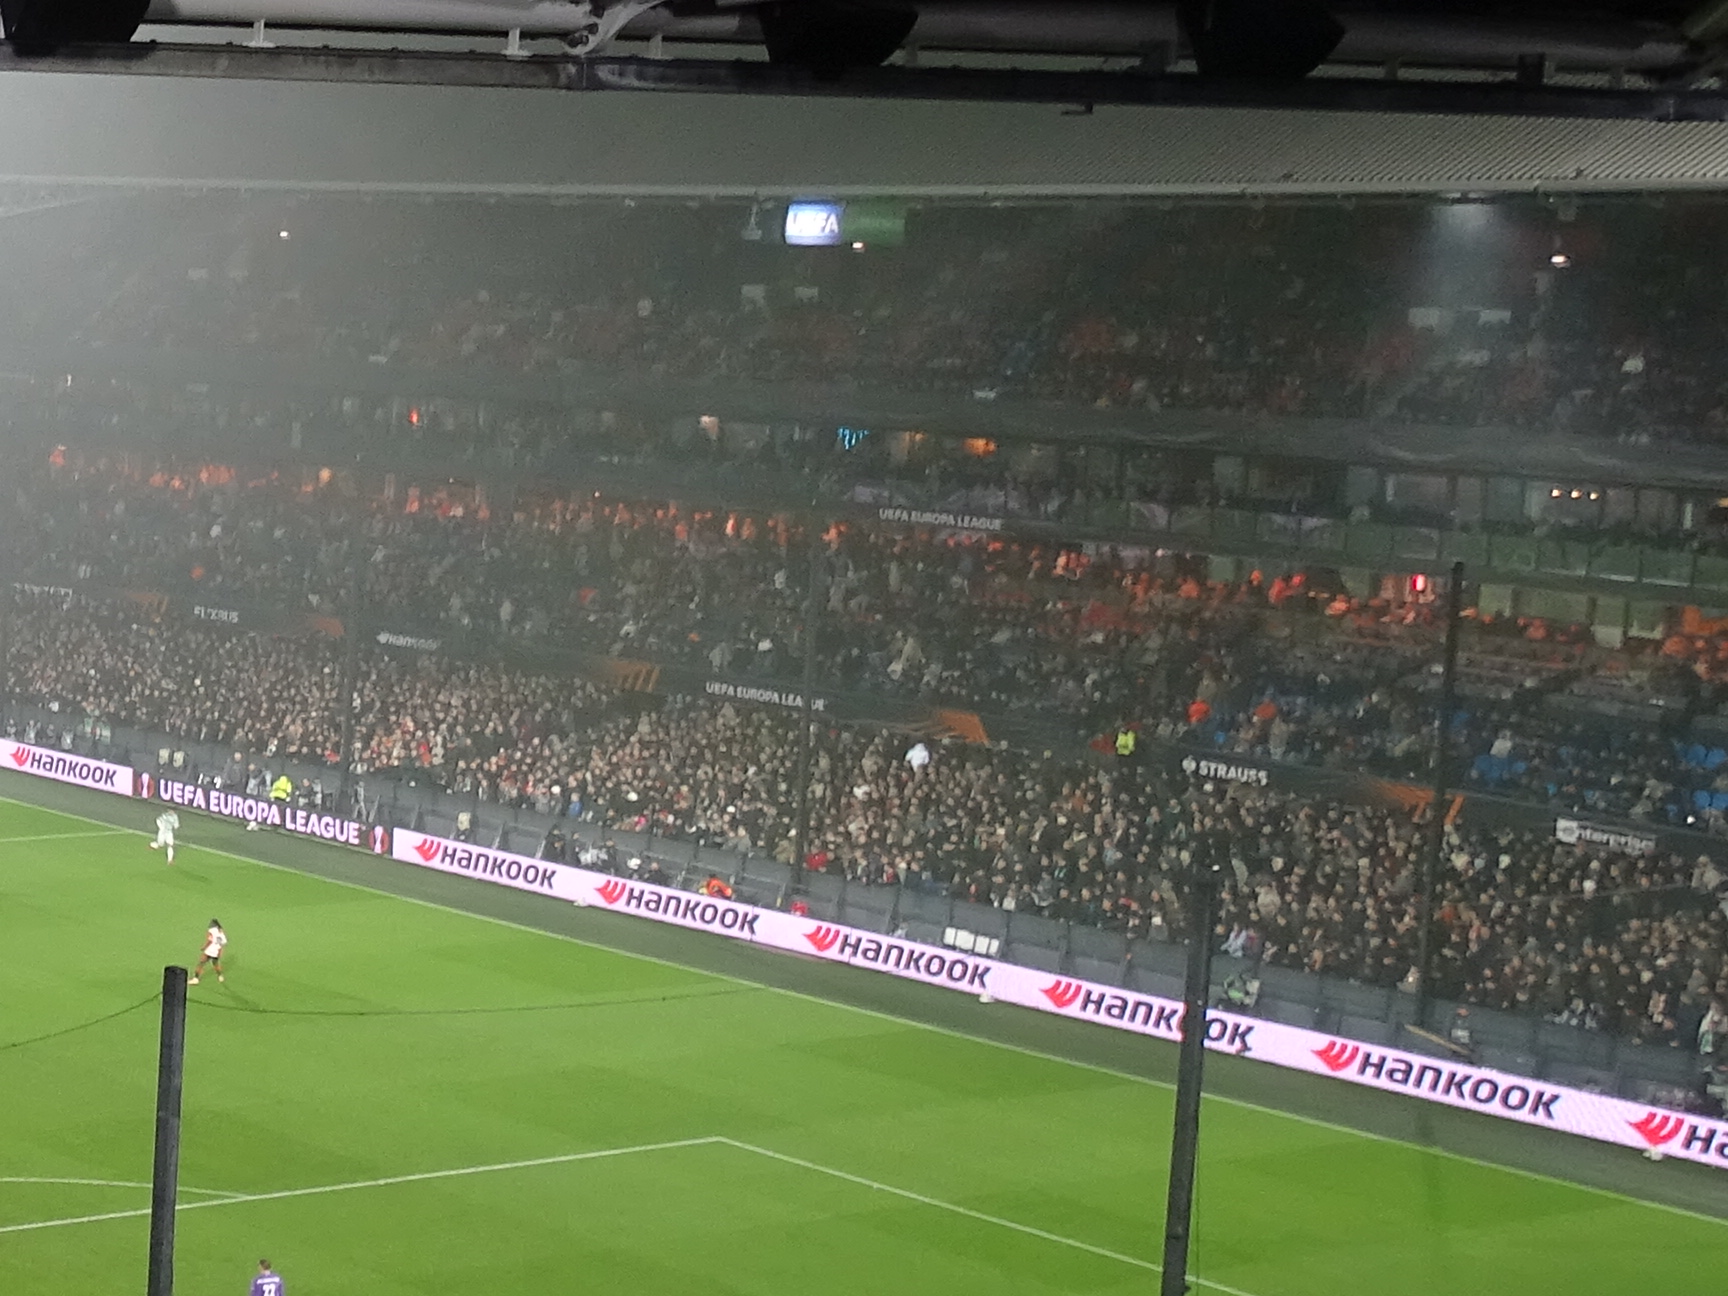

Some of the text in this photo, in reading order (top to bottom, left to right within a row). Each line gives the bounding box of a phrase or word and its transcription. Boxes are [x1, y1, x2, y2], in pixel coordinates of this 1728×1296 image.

[705, 681, 825, 711] UEFA EUROPA LEAUE
[159, 778, 360, 844] UEFA EUROPA LEAGUE
